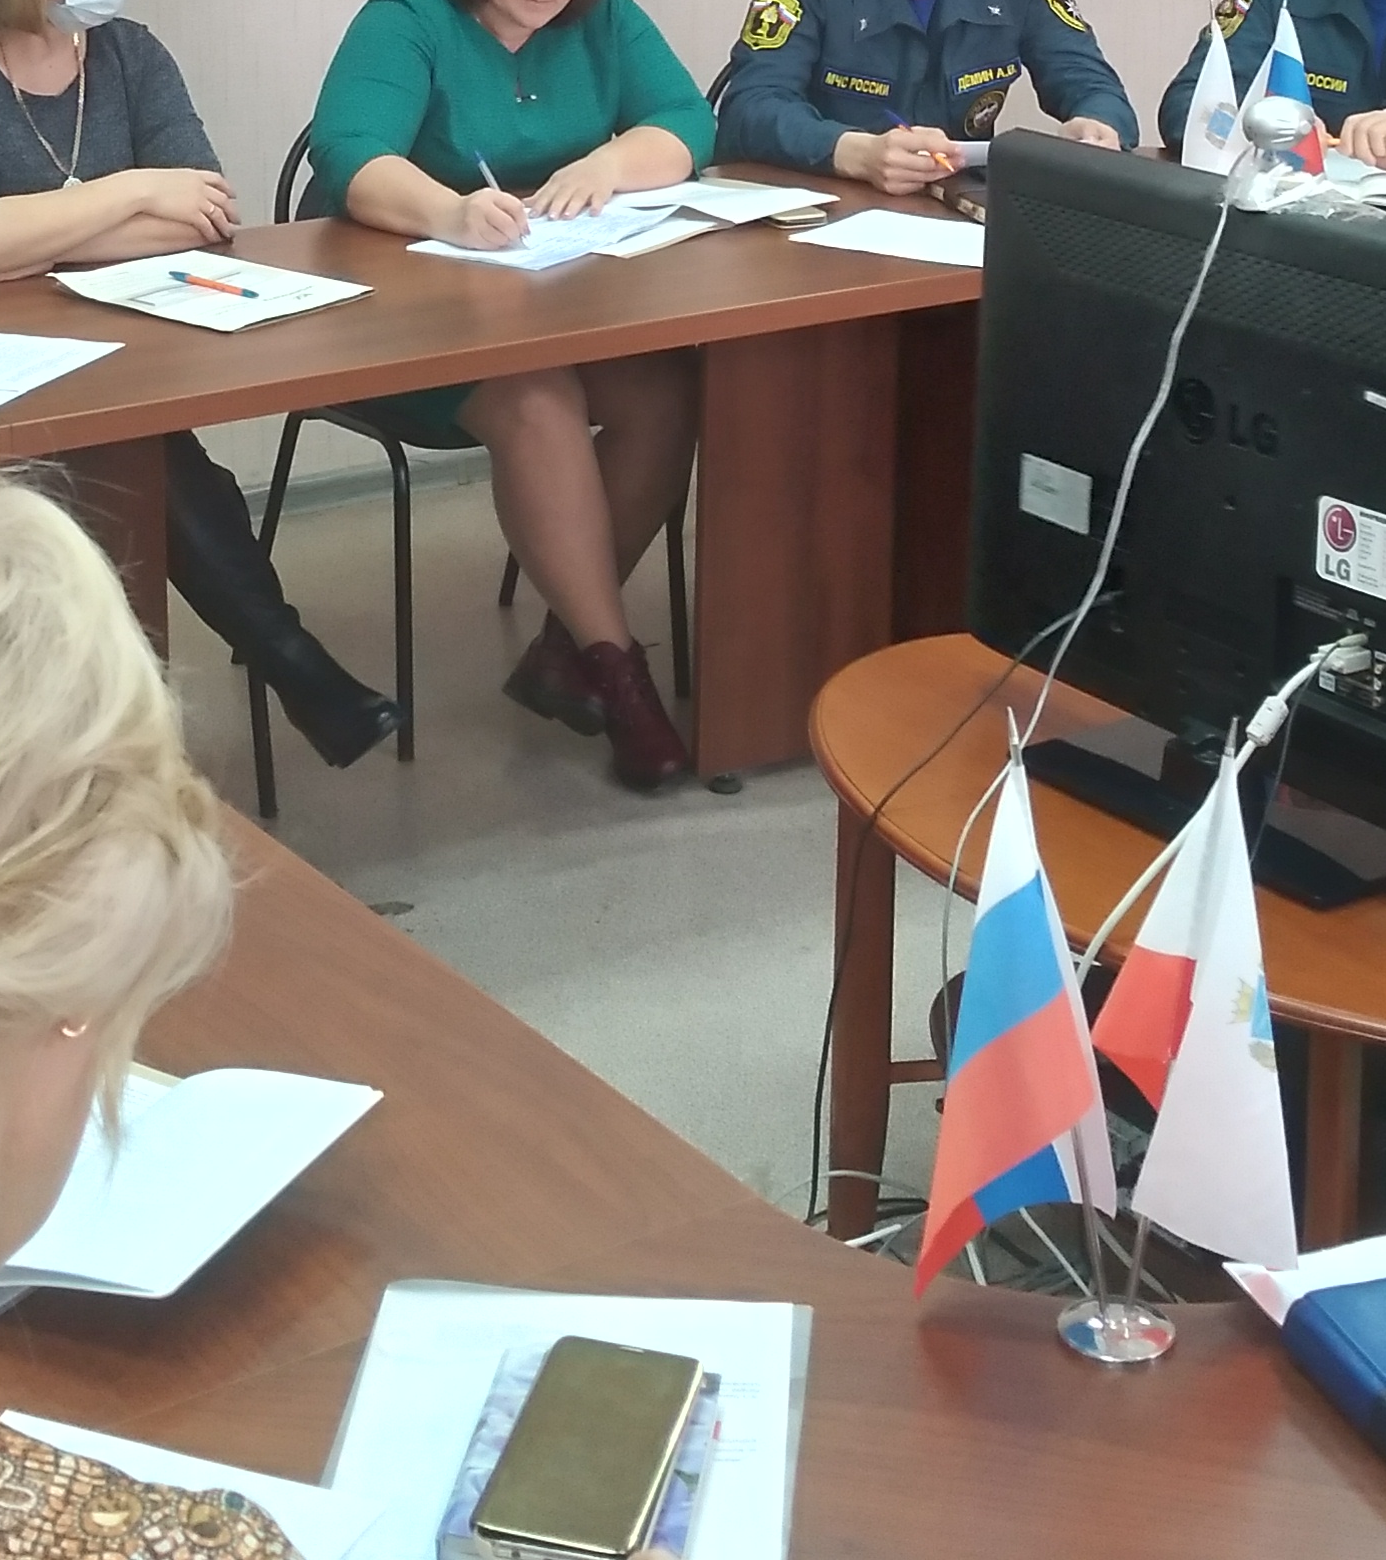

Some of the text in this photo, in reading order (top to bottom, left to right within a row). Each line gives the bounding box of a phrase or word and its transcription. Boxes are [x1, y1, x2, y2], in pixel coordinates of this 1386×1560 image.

[824, 72, 891, 97] МЧС РОССИИ
[1305, 73, 1348, 93] ОССИИ
[1229, 402, 1280, 458] LG
[1324, 553, 1351, 582] LG
